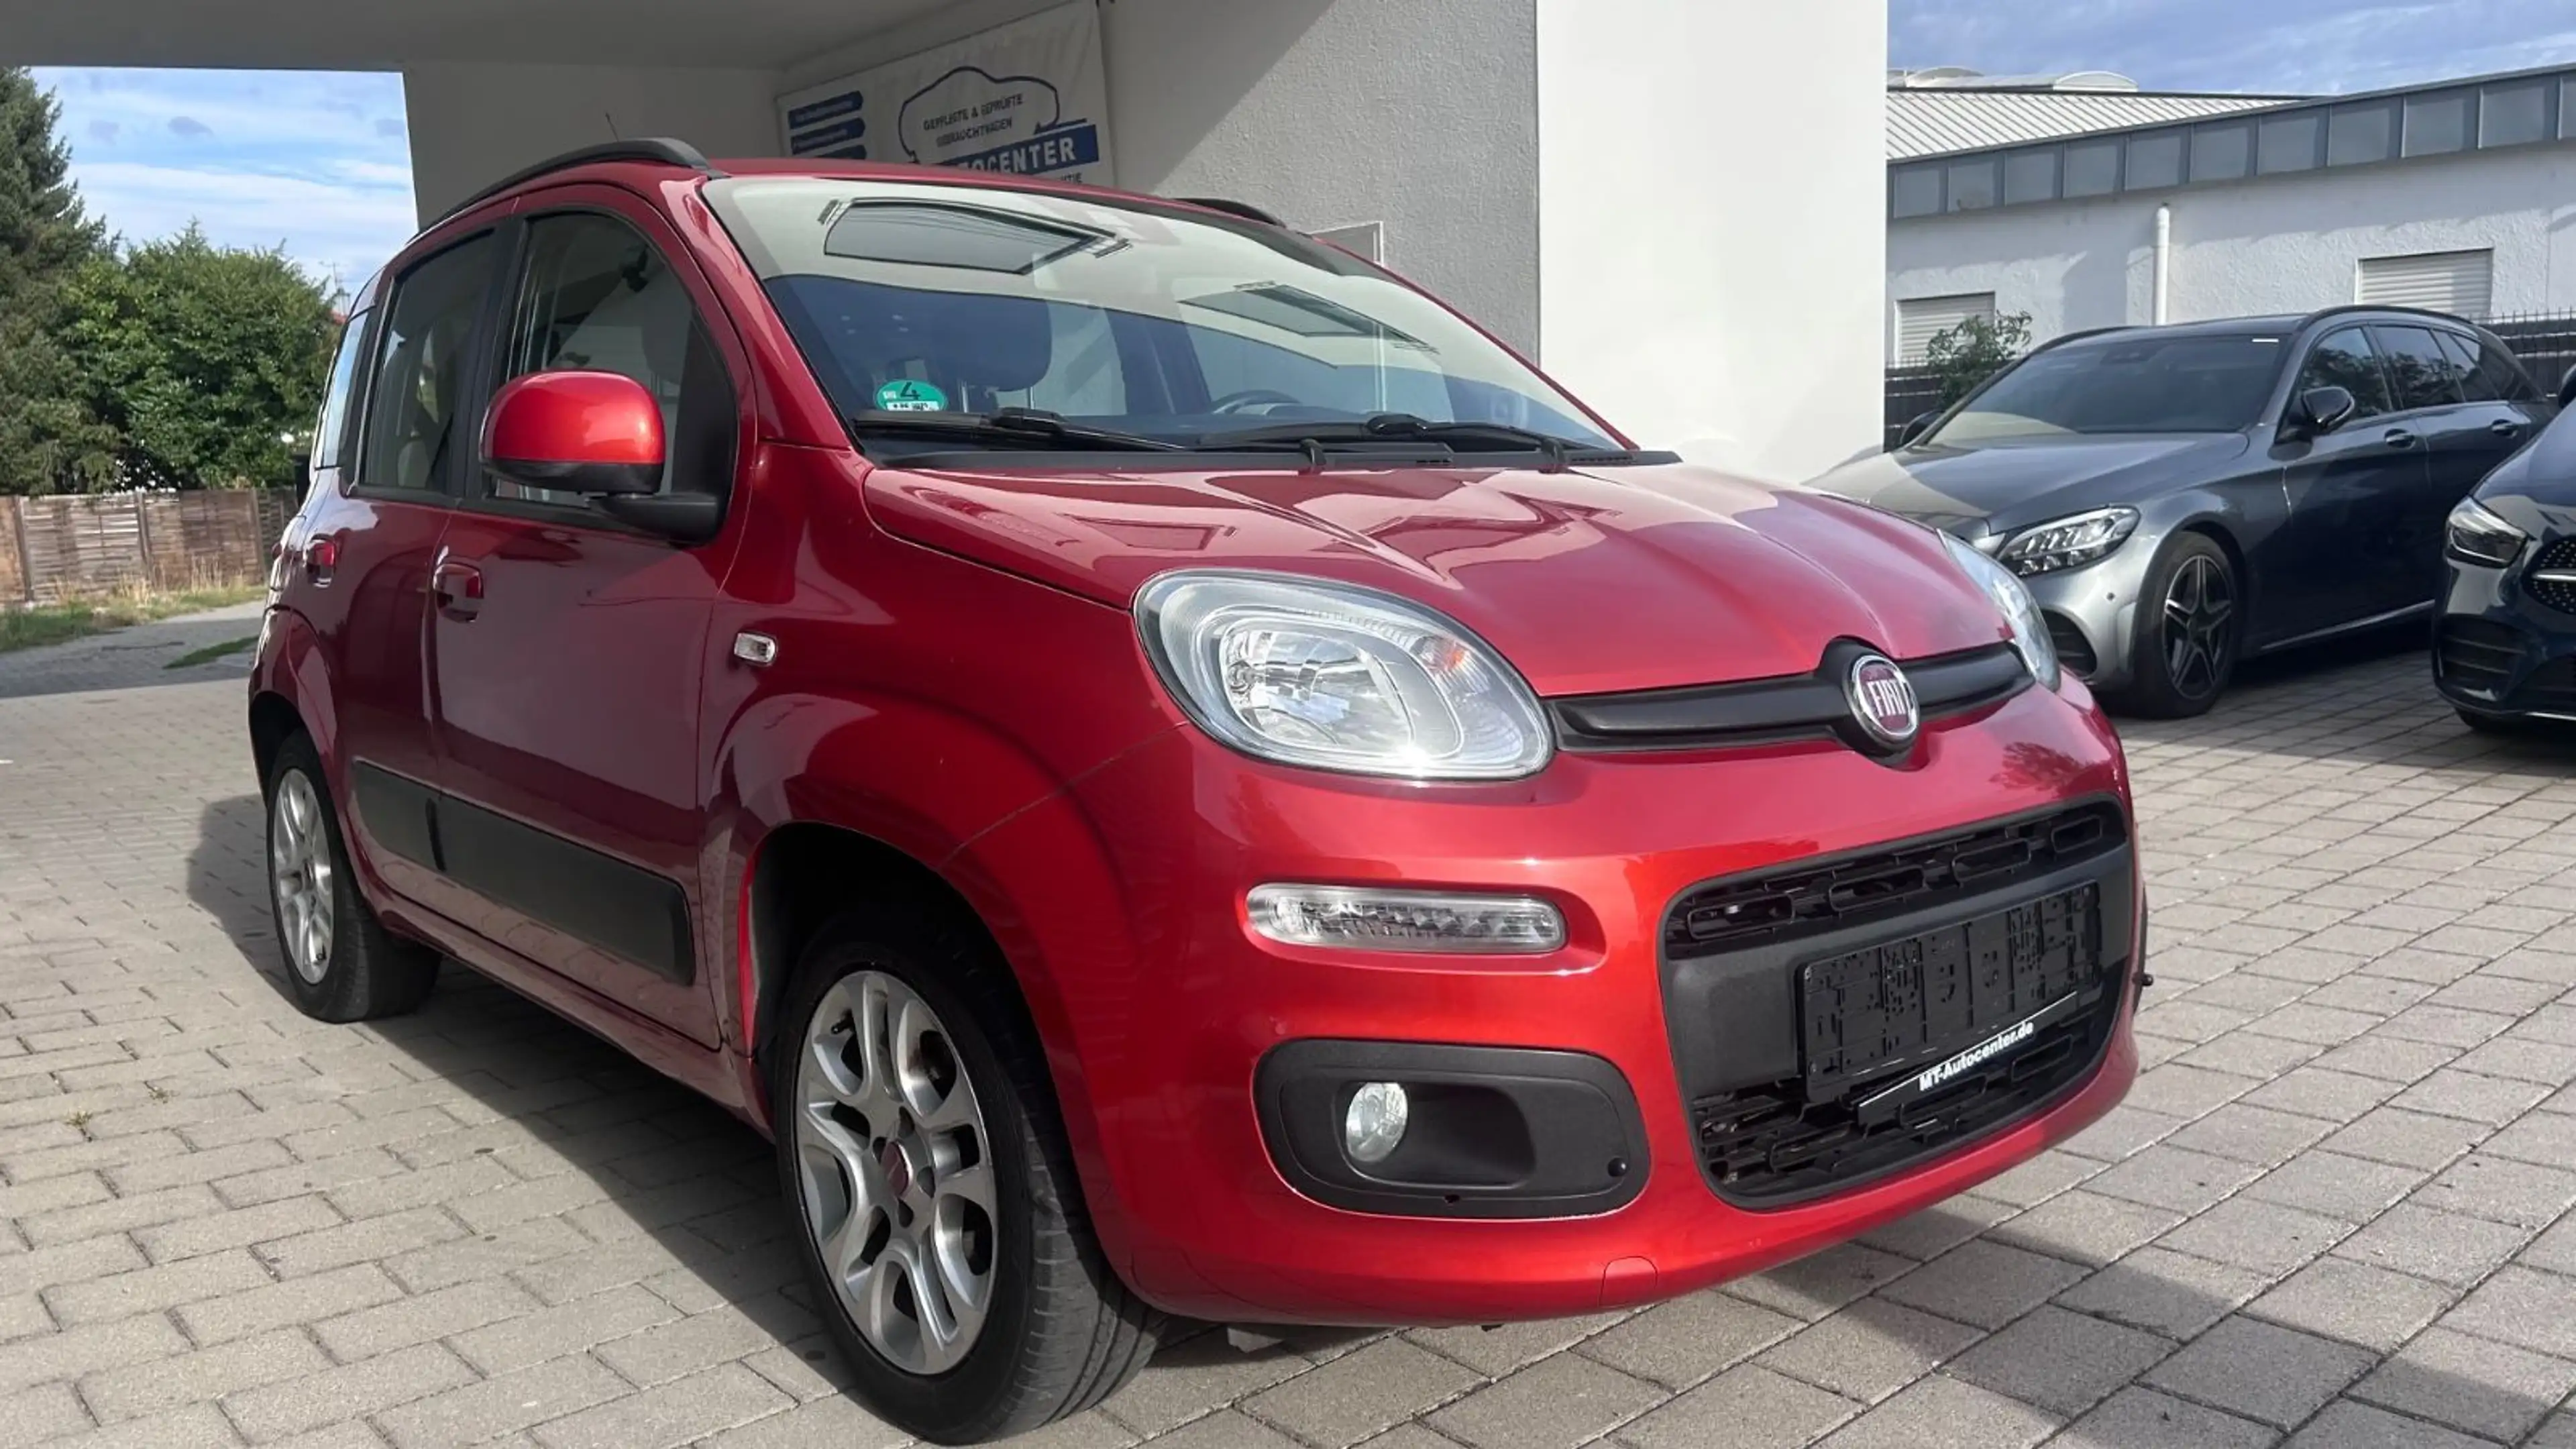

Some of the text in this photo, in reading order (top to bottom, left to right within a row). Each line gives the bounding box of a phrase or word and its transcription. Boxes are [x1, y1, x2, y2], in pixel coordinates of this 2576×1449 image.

[958, 137, 1076, 173] OCENTER
[900, 381, 921, 400] 4
[1867, 679, 1906, 717] FIAT
[1919, 1021, 2034, 1091] MT-Autocenter.de
